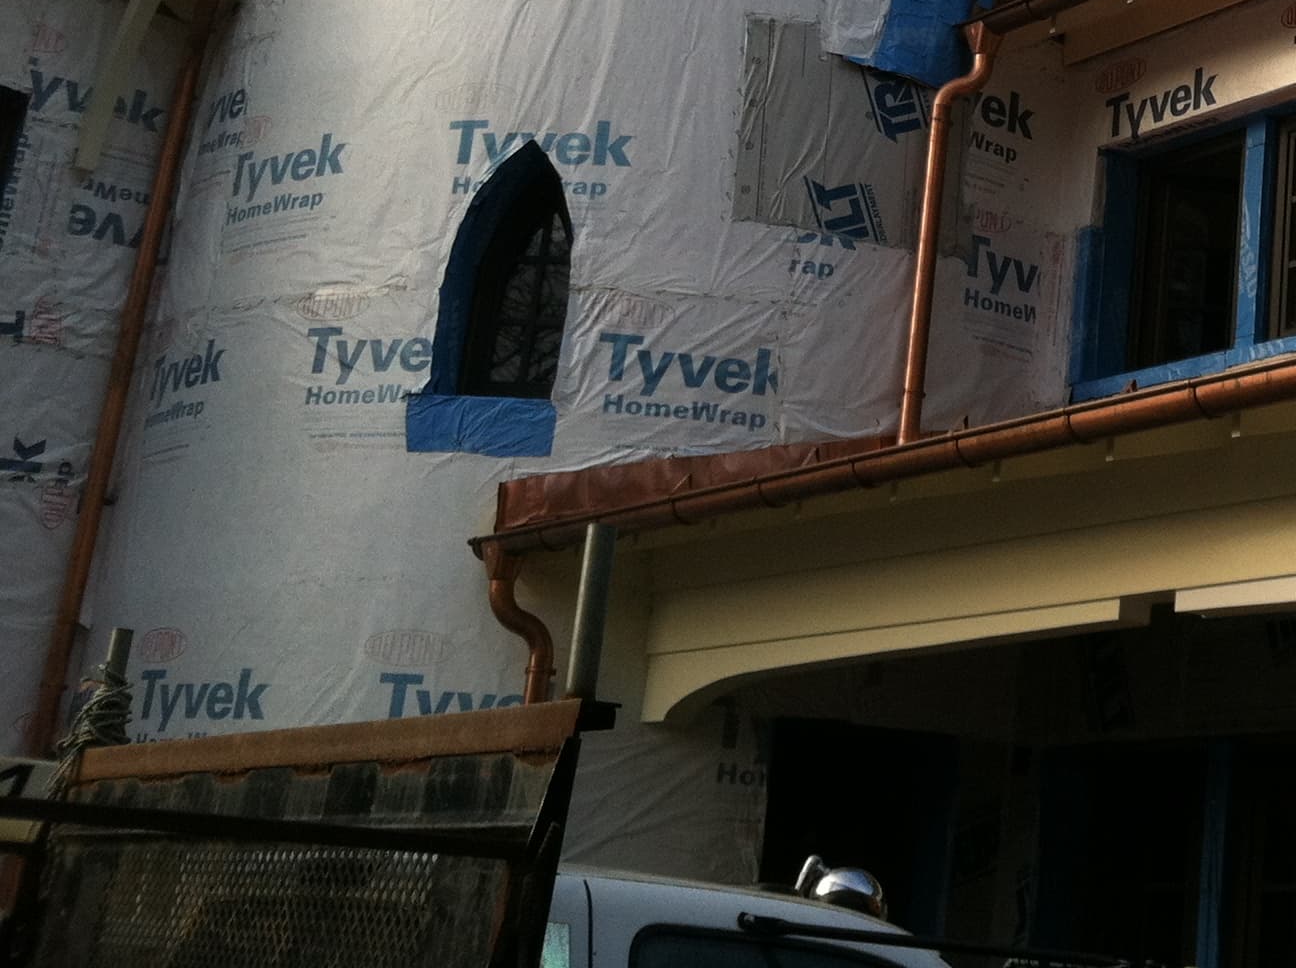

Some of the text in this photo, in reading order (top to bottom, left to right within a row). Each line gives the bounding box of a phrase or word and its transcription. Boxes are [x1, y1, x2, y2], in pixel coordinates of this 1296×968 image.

[1106, 67, 1218, 139] Tyvek
[231, 133, 348, 202] Tyvek
[226, 192, 323, 226] HomeWrap
[967, 235, 1040, 295] Tyv
[150, 339, 227, 409] Tyvek
[307, 326, 432, 385] Tyve
[602, 394, 767, 432] HomeWrap
[141, 668, 272, 733] Tyvek
